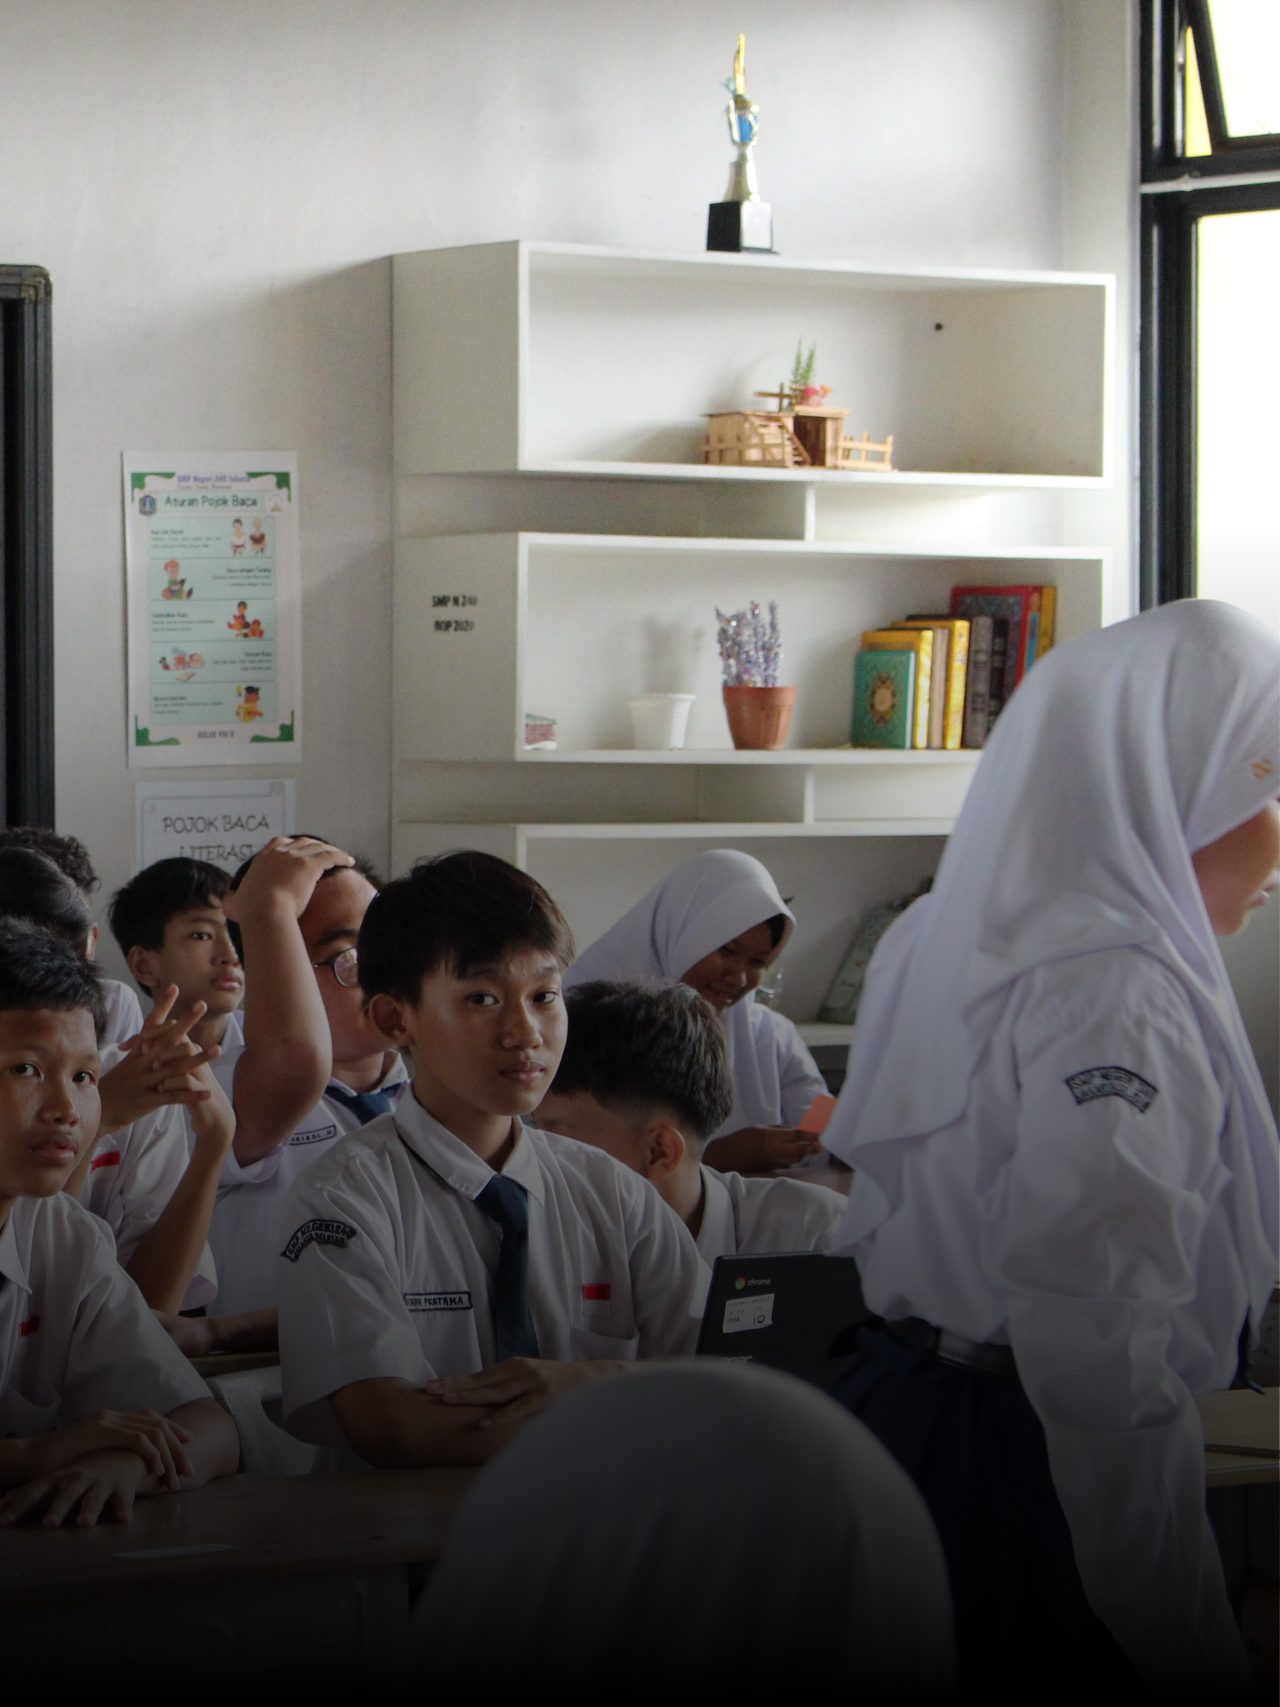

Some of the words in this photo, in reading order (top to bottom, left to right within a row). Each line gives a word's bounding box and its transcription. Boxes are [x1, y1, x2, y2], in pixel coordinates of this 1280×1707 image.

[165, 495, 199, 507] Aturan
[201, 496, 229, 509] Pojok
[231, 495, 257, 507] Baca
[432, 595, 451, 608] SMP
[163, 816, 220, 834] POJOK
[222, 815, 270, 832] BACA
[747, 1278, 772, 1286] chrome
[424, 1296, 464, 1306] PRATAMA
